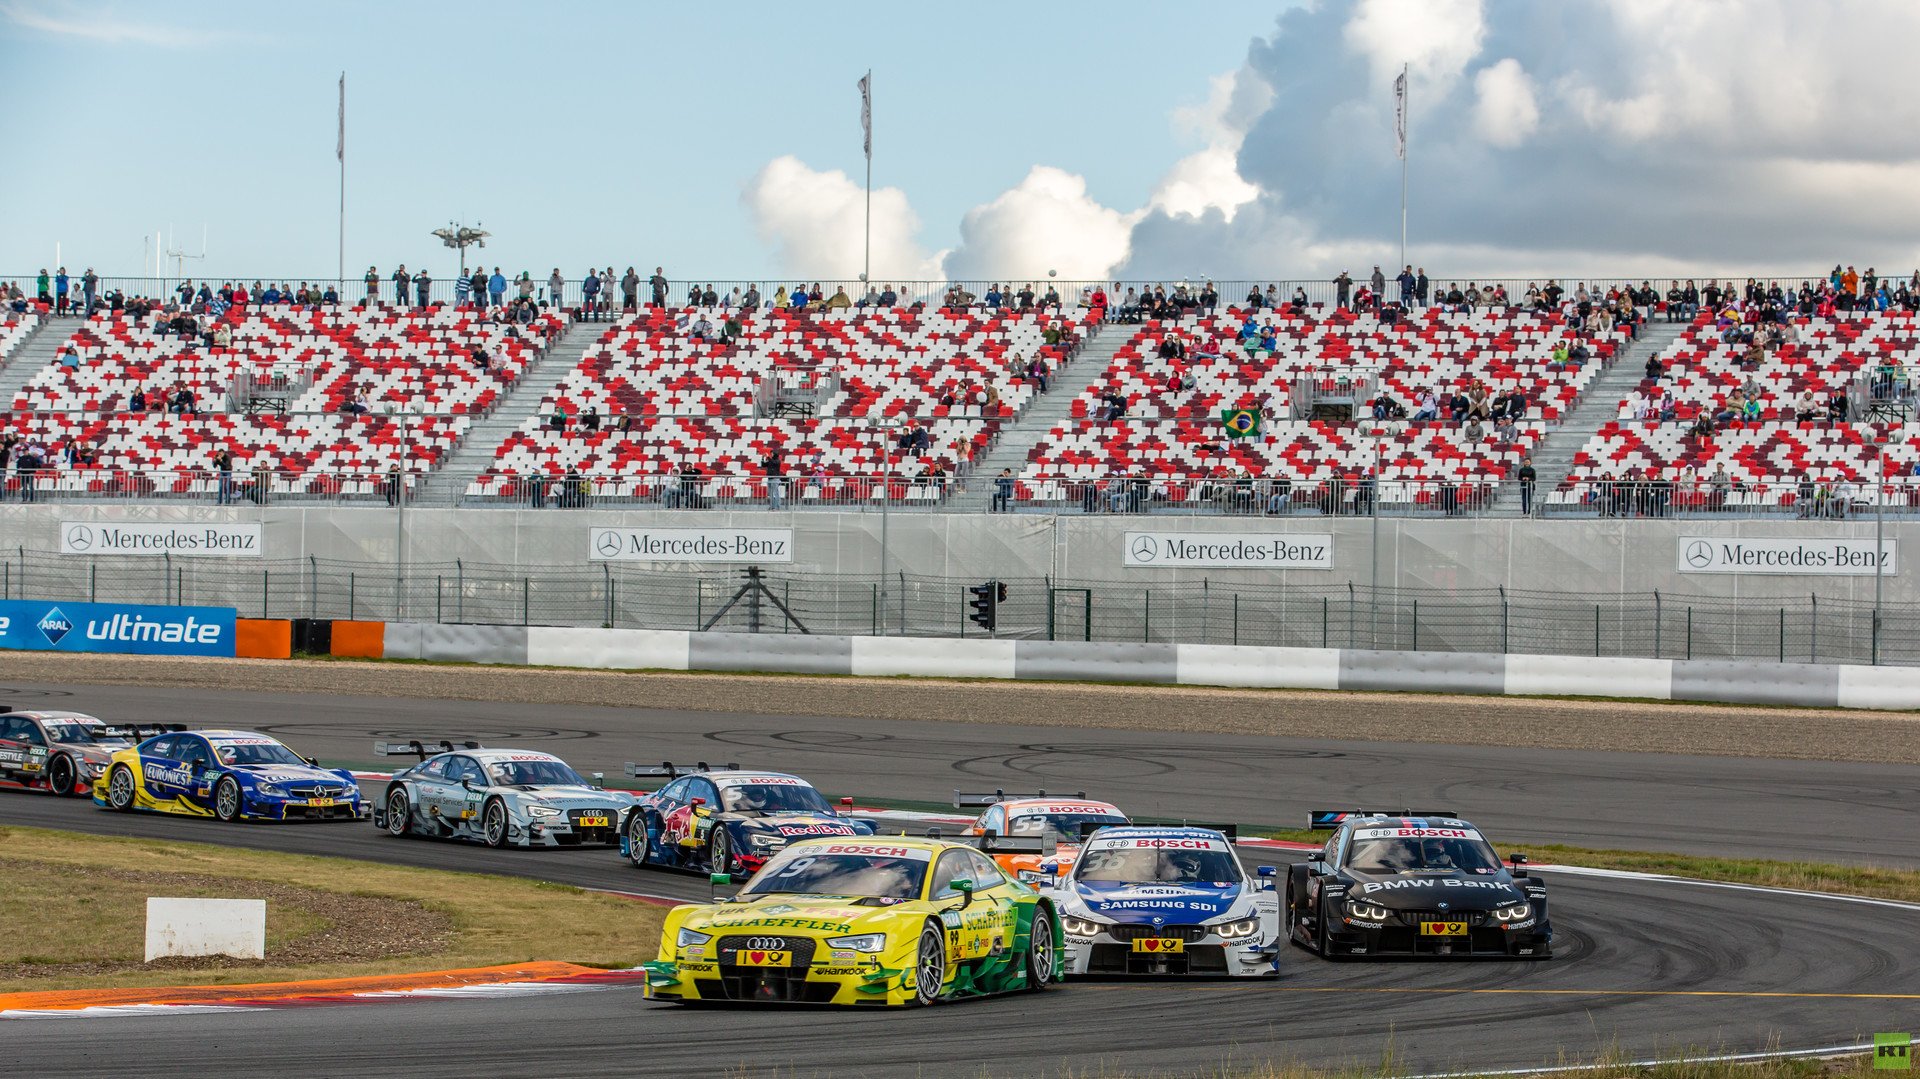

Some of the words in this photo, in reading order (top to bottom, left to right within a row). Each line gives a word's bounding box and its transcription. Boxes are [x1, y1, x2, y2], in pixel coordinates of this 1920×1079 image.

[100, 528, 255, 549] Mercedes-Benz
[629, 534, 785, 555] Mercedes-Benz
[1165, 539, 1325, 561] Mercedes-Benz
[1721, 544, 1889, 566] Mercedes-Benz
[41, 620, 69, 631] ARAL
[86, 613, 221, 644] ultimate
[47, 726, 71, 740] 31
[221, 746, 237, 759] 2
[147, 767, 186, 786] EURONICS
[490, 762, 516, 777] 51
[727, 786, 743, 800] 5
[1049, 806, 1108, 814] BOSCH
[780, 825, 819, 836] Red
[819, 825, 856, 836] Bull
[1013, 815, 1047, 832] 53
[1397, 829, 1466, 838] BOSCH
[826, 845, 908, 857] BOSCH
[1136, 839, 1211, 849] BOSCH
[1362, 879, 1434, 894] BMW
[1441, 879, 1513, 893] Bank
[1100, 901, 1185, 910] SAMSUNG
[1189, 902, 1217, 912] SDI
[698, 918, 852, 934] SCHAEFFLER
[950, 930, 959, 946] 99
